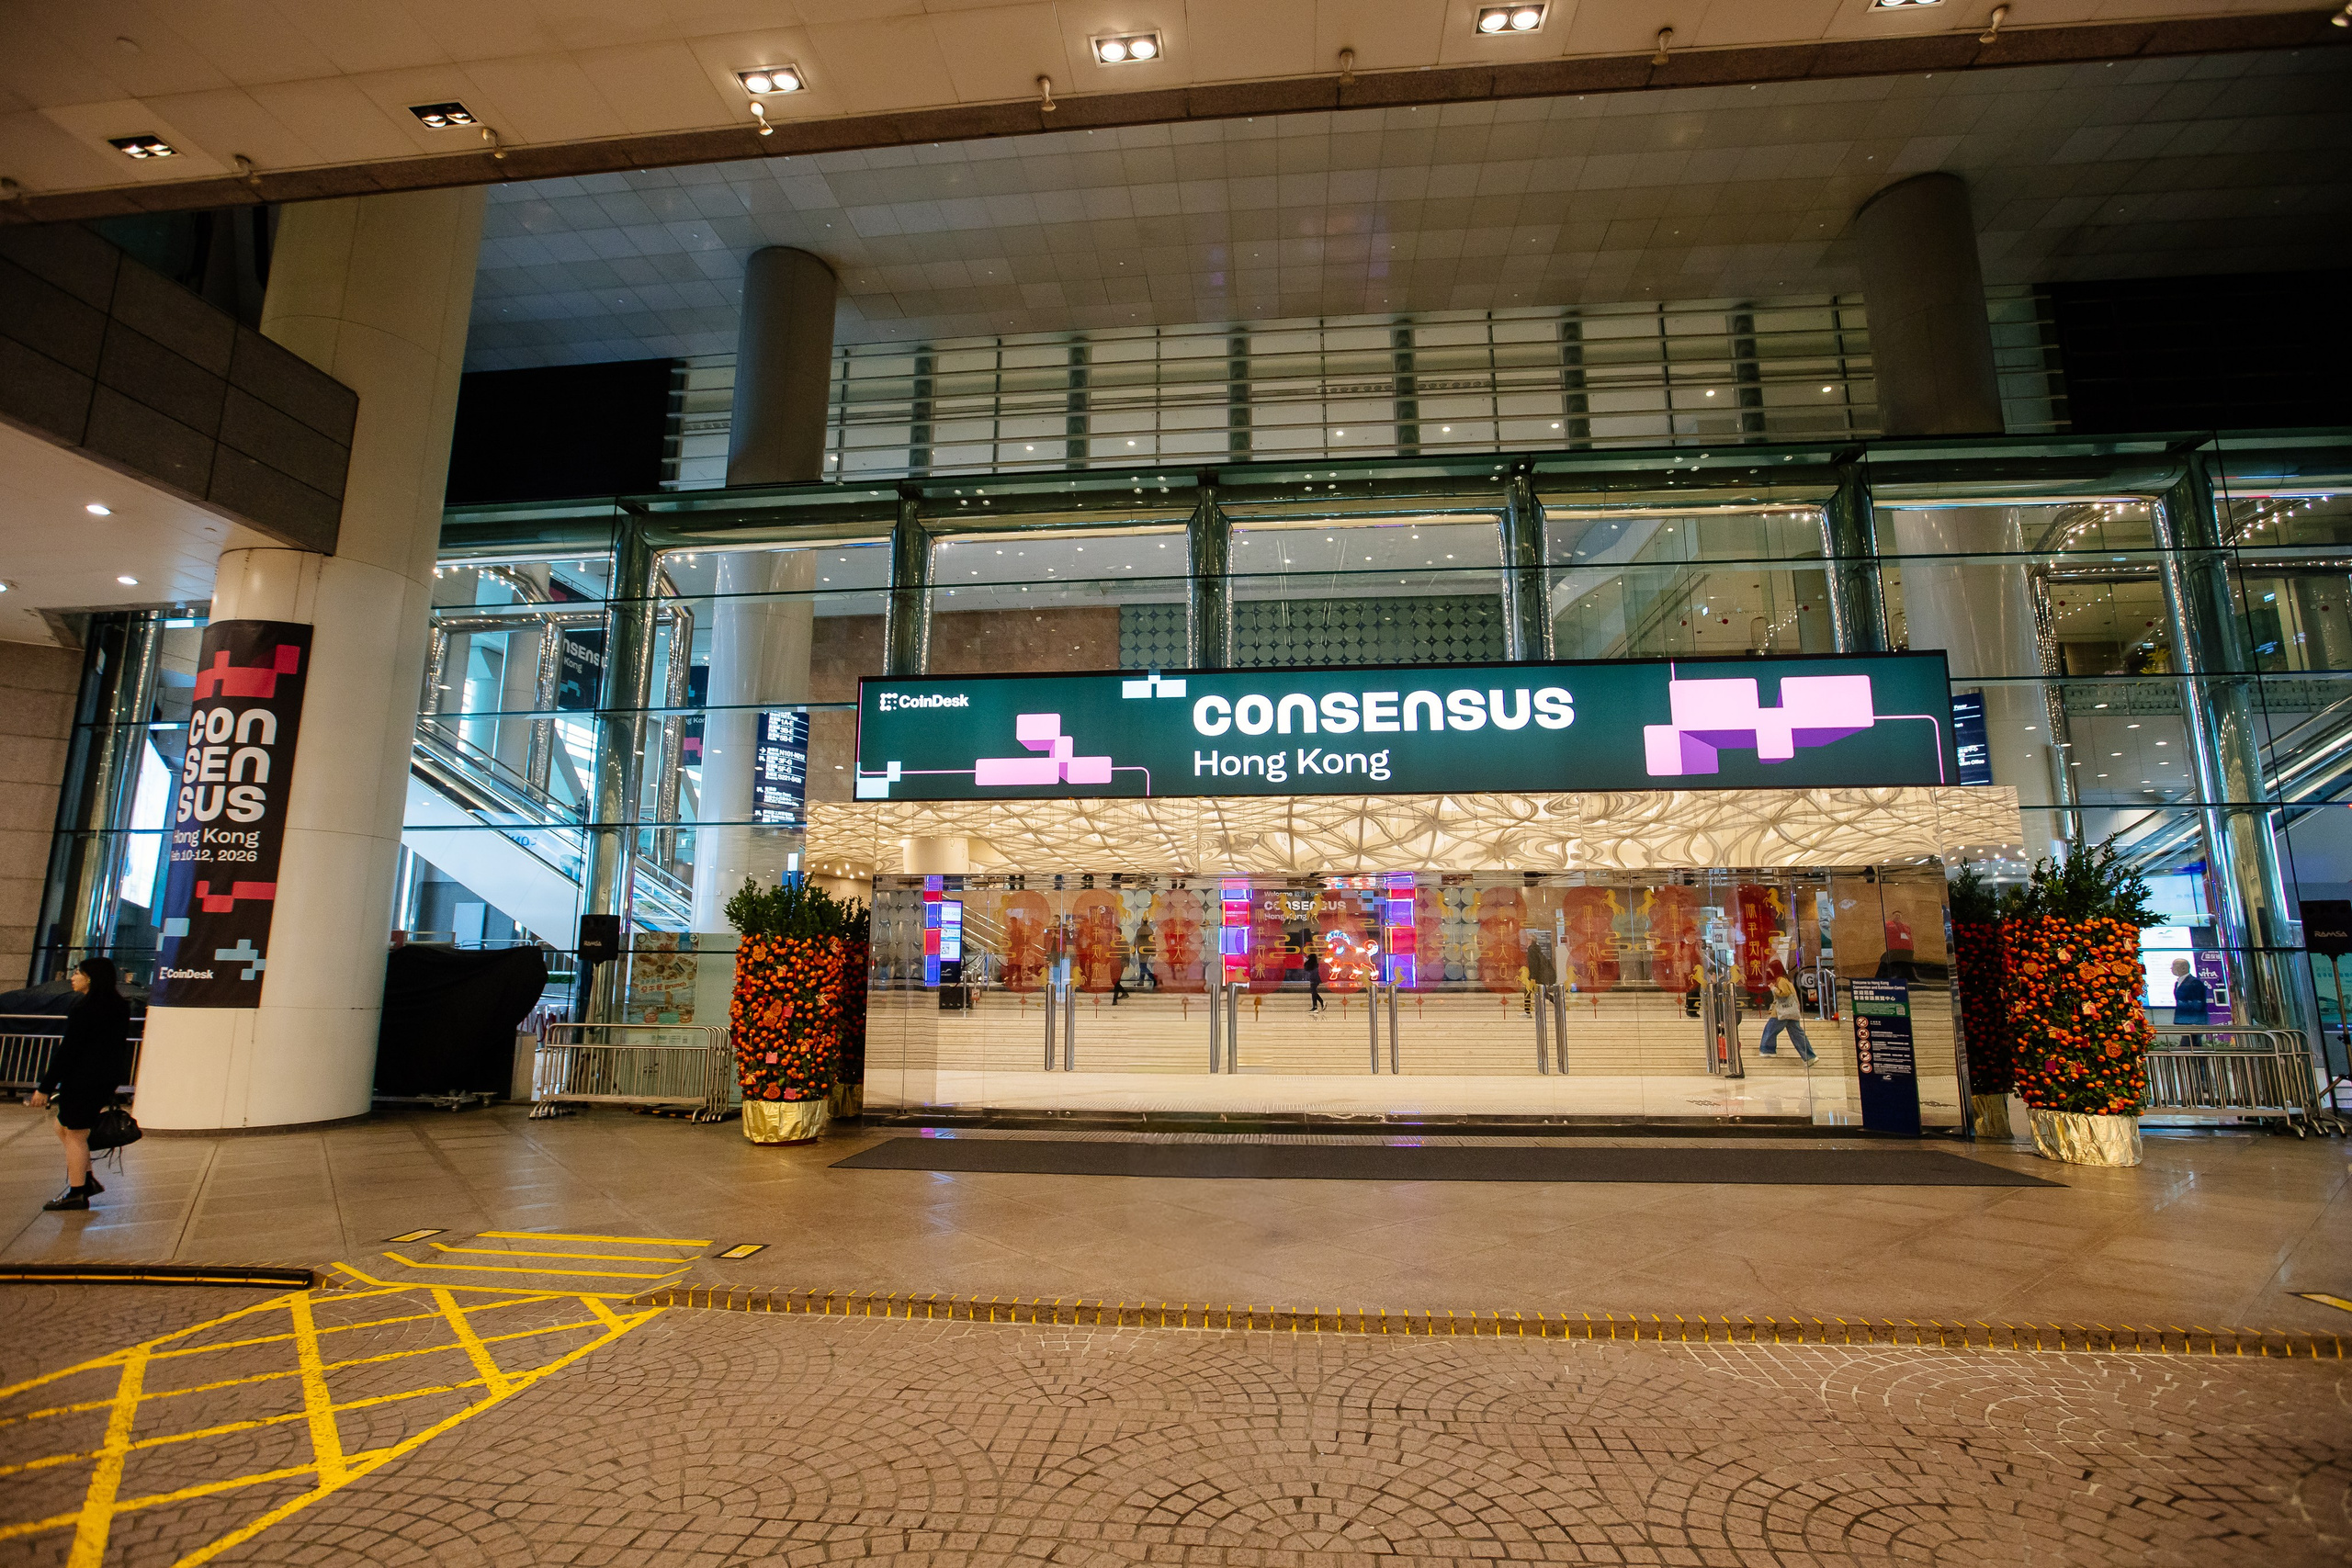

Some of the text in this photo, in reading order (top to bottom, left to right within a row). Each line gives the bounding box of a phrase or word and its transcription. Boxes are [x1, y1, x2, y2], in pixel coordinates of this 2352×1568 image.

[563, 657, 583, 674] Kong
[899, 694, 969, 708] CoinDesk
[1193, 748, 1392, 784] Hong Kong
[176, 784, 267, 824] SUS
[173, 828, 261, 850] Hong Kong
[181, 849, 214, 863] 10-12,
[217, 850, 258, 863] 2026
[167, 968, 214, 979] CoinDesk
[1806, 976, 1814, 985] G
